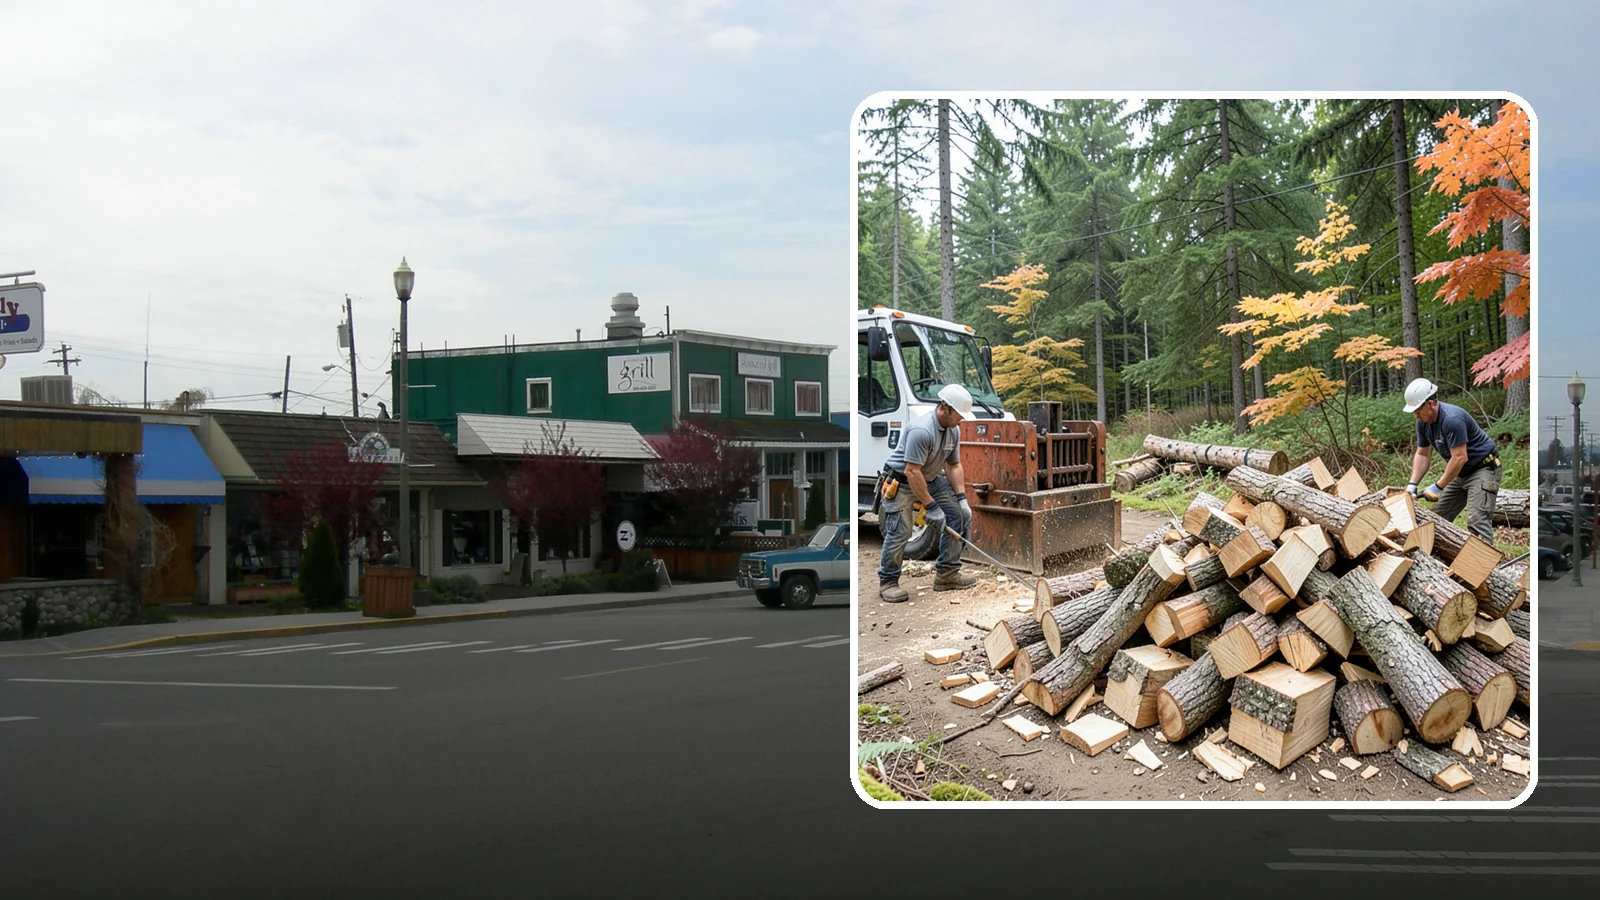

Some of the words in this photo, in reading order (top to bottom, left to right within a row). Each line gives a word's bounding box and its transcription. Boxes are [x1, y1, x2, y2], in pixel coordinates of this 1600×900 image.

[3, 338, 16, 346] Fries
[20, 337, 38, 345] Salads
[617, 355, 655, 391] grill
